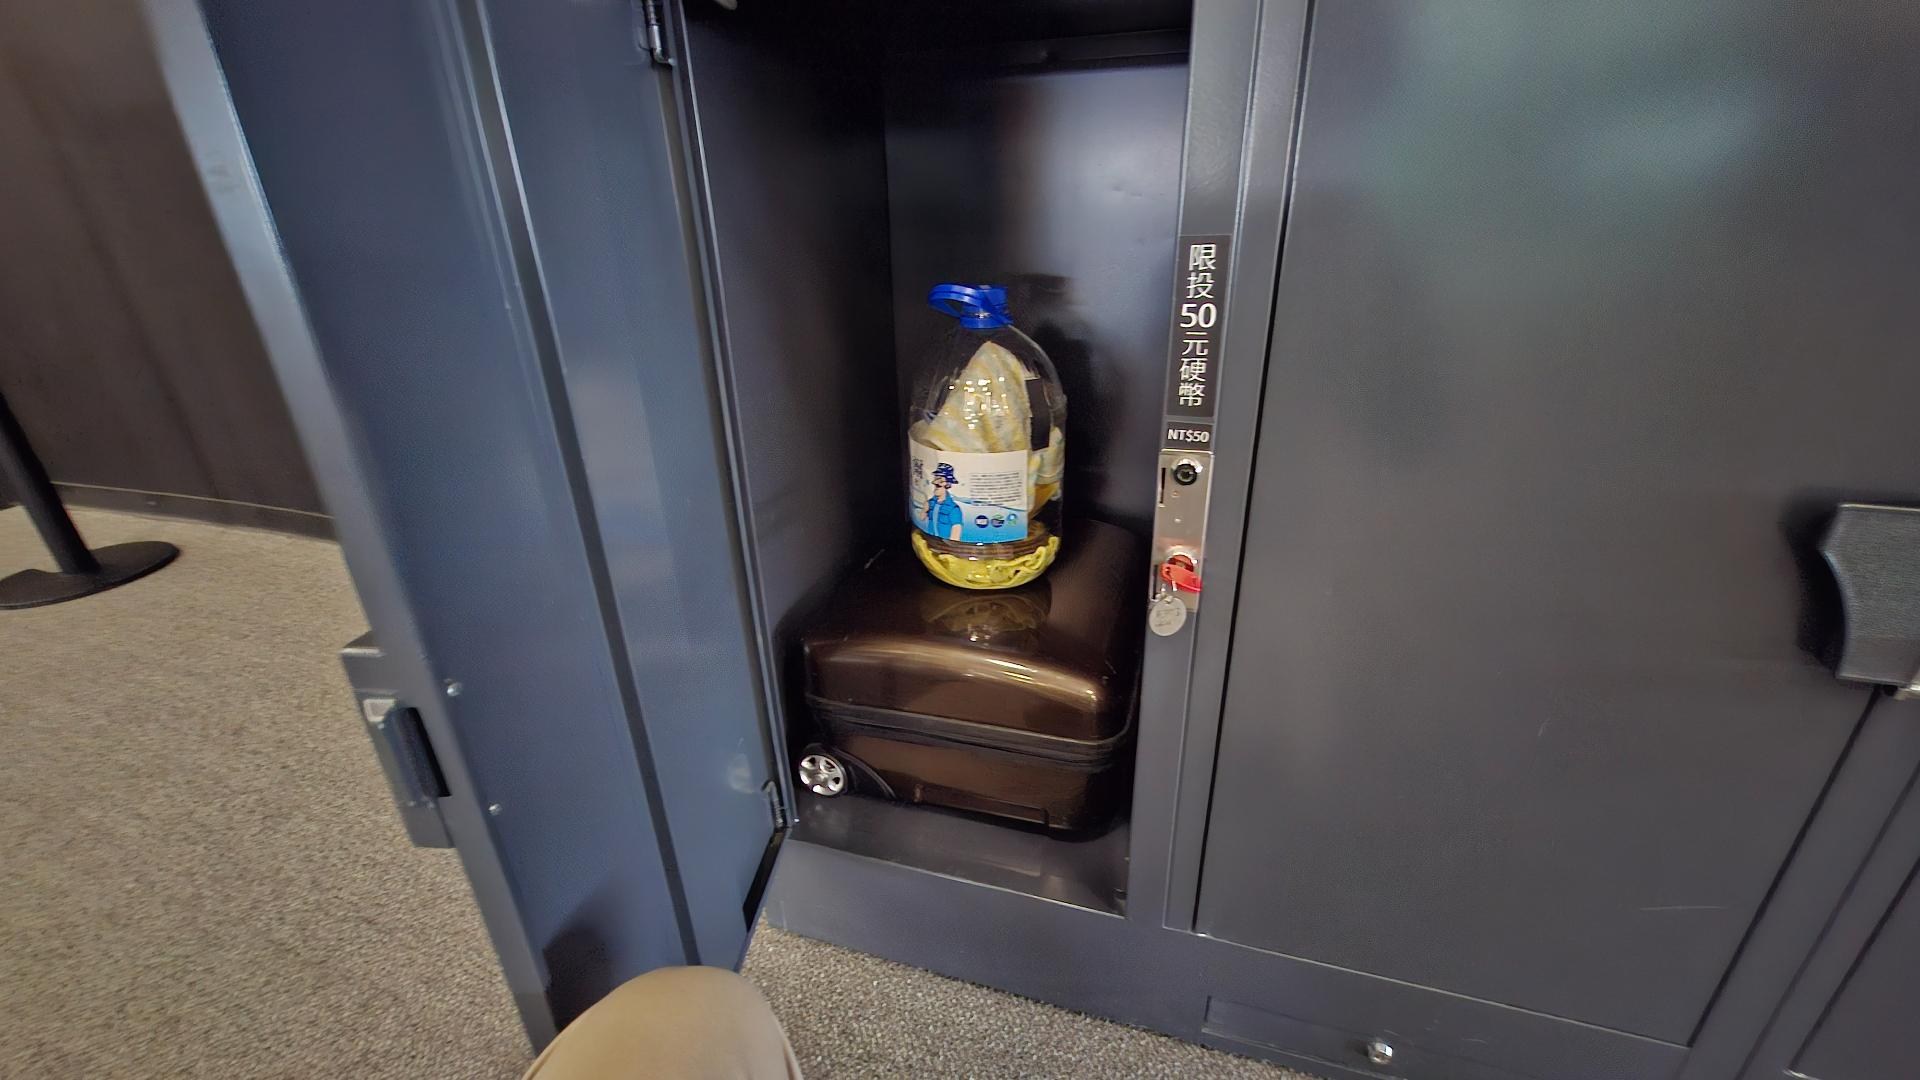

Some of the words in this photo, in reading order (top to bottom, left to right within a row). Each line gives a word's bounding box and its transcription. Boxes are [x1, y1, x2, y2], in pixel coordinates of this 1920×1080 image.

[1178, 243, 1217, 407] 限投50元硬幣
[1167, 429, 1209, 443] NT$50
